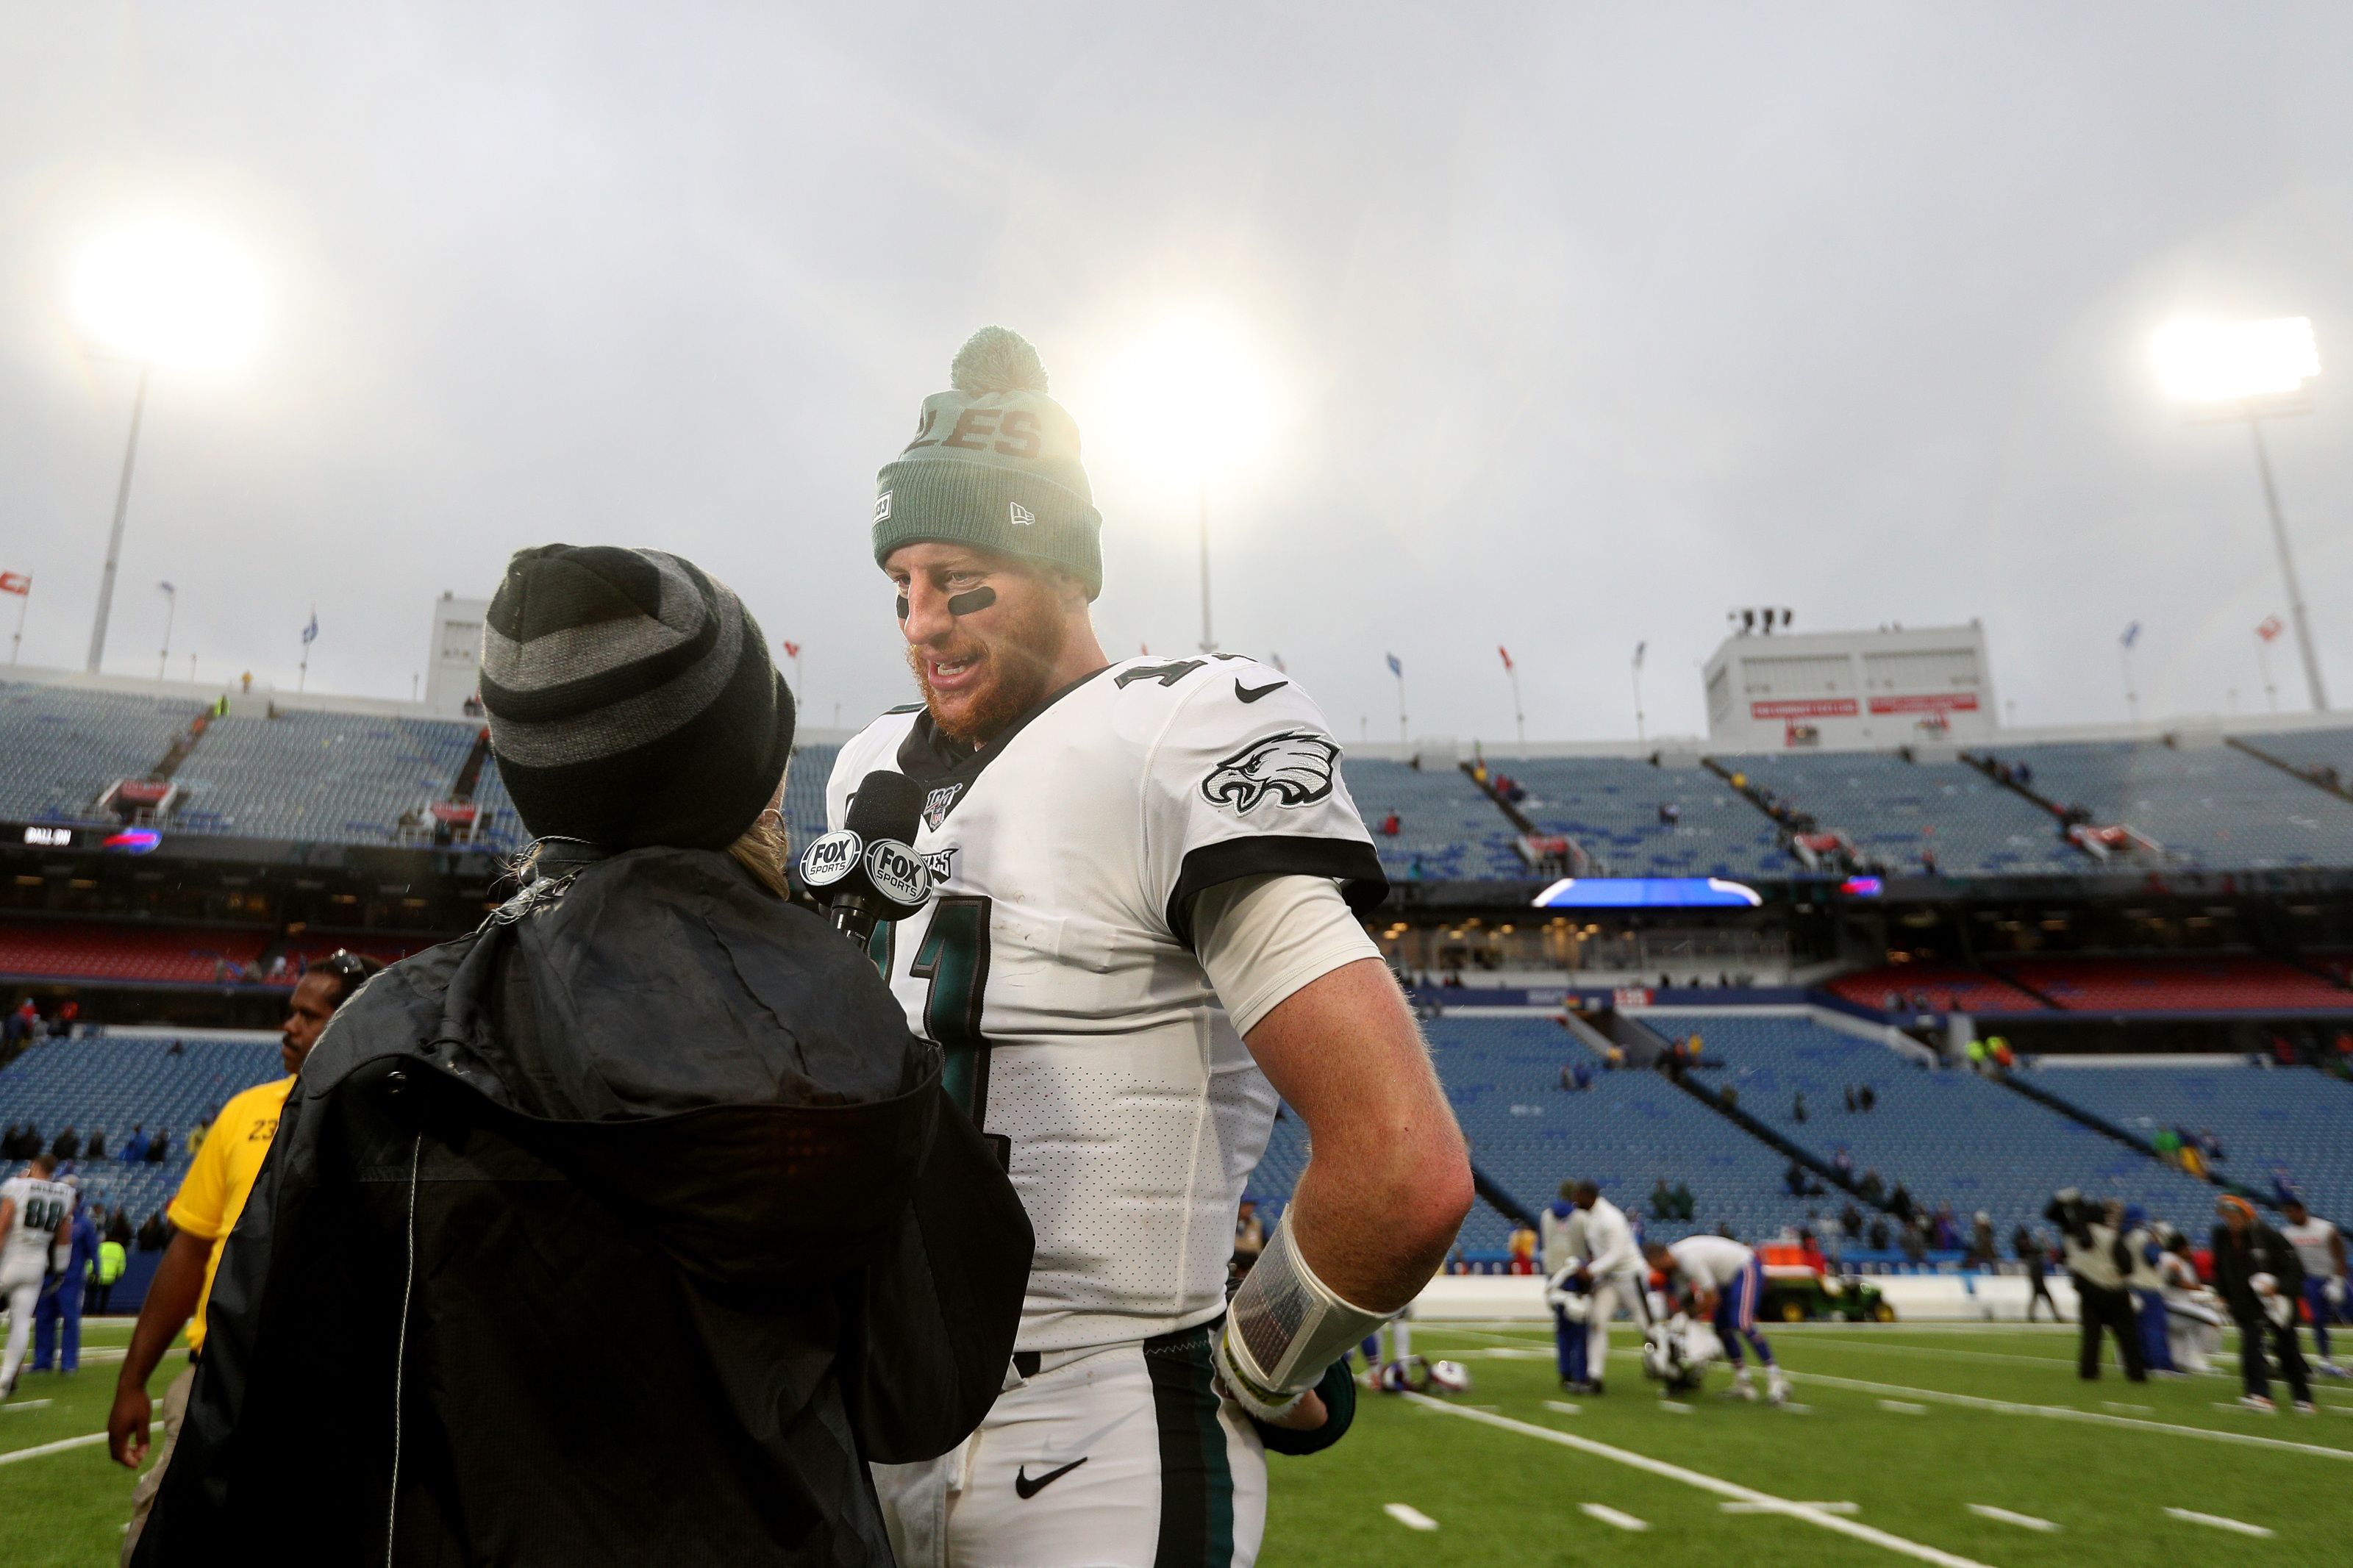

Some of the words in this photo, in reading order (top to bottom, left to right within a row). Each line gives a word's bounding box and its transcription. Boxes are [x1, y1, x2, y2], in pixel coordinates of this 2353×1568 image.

[813, 839, 851, 866] FOX
[810, 862, 846, 875] SPORTS
[879, 847, 921, 887] FOX
[876, 869, 917, 897] SPORTS
